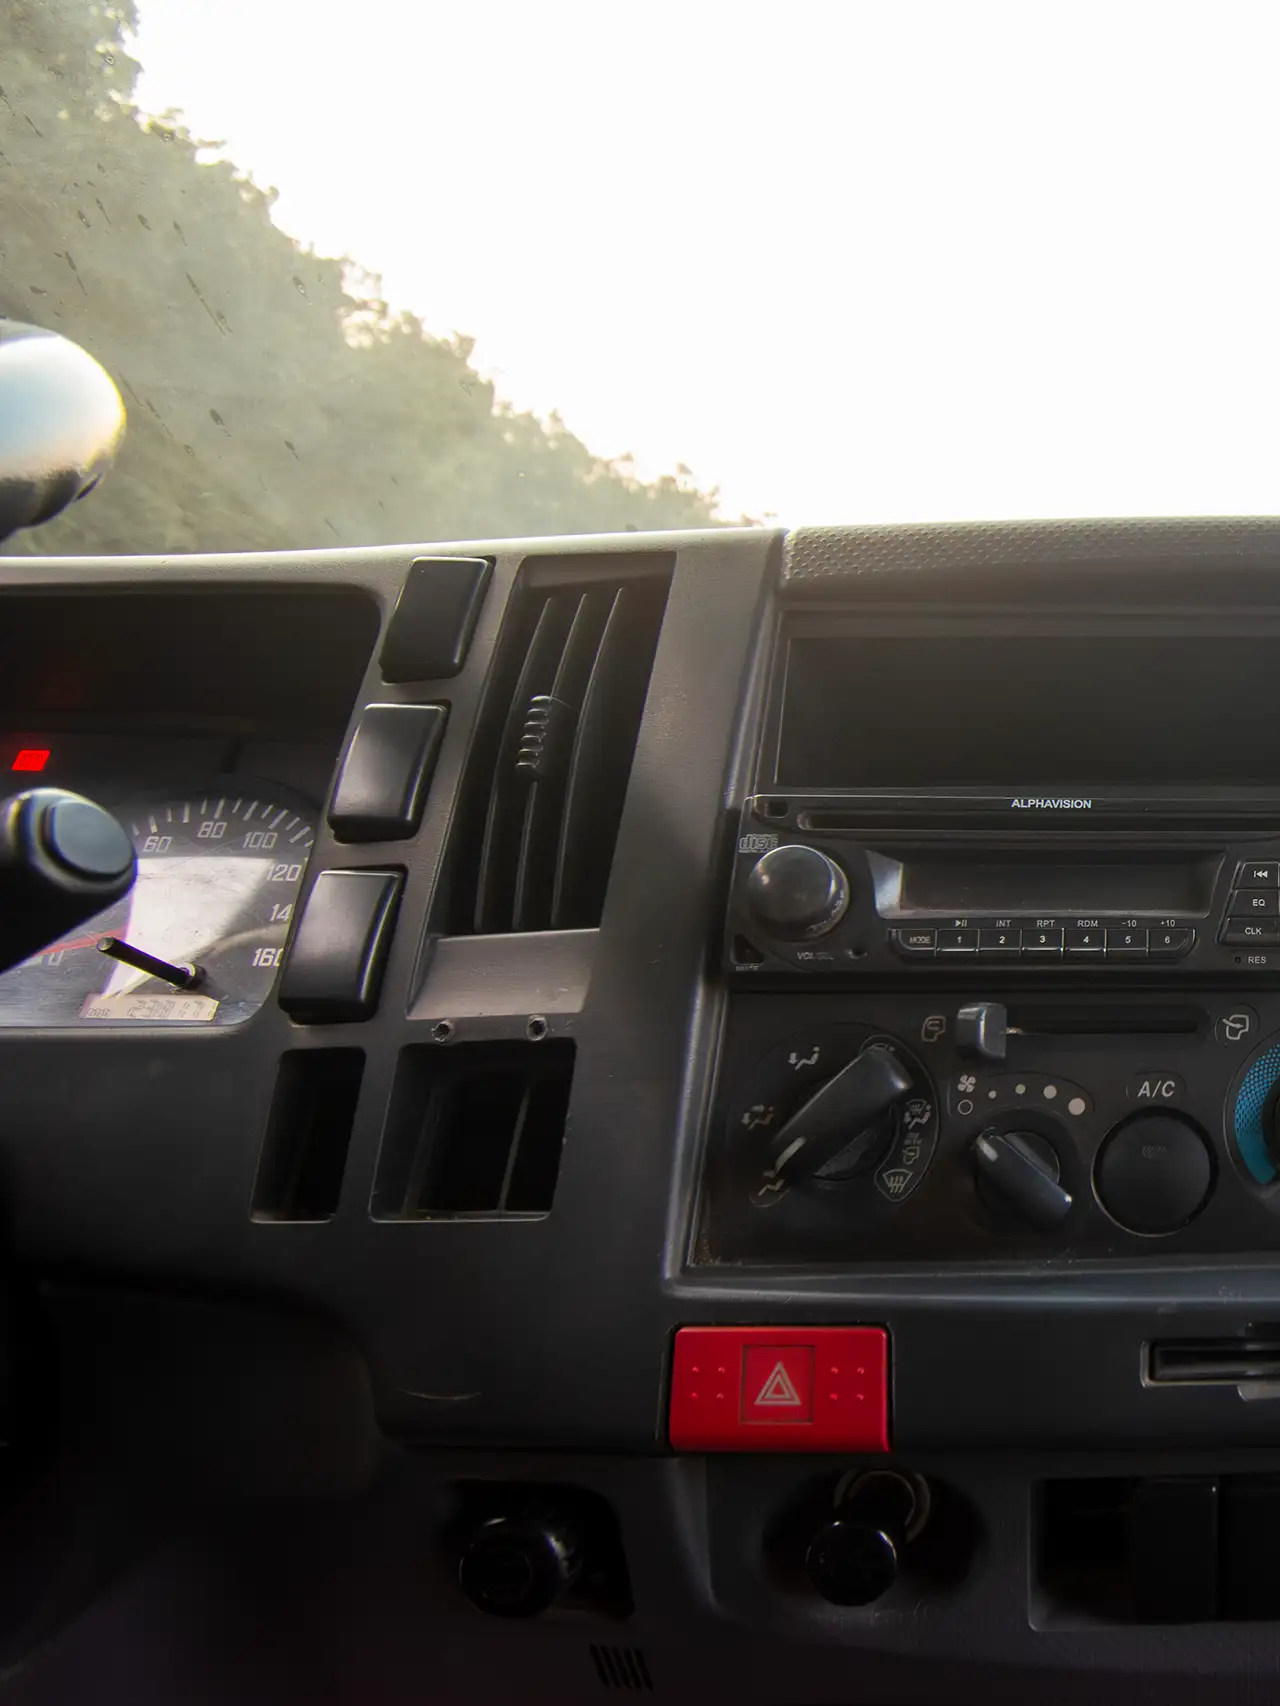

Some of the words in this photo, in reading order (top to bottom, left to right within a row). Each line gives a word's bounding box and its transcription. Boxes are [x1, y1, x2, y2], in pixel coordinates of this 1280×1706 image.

[1011, 799, 1092, 809] ALPHAVISION
[198, 821, 228, 839] 80
[142, 836, 172, 853] 60
[243, 832, 278, 849] 100
[266, 864, 302, 882] 120
[1252, 898, 1266, 907] EQ
[269, 903, 293, 922] 14
[1245, 927, 1262, 935] CLK
[909, 936, 931, 944] MODE
[999, 936, 1005, 944] 2
[1040, 935, 1046, 944] 3
[1083, 936, 1089, 944] 4
[1125, 936, 1131, 944] 5
[1164, 936, 1171, 944] 6
[1248, 956, 1267, 964] RES
[1137, 1080, 1176, 1098] A/C
